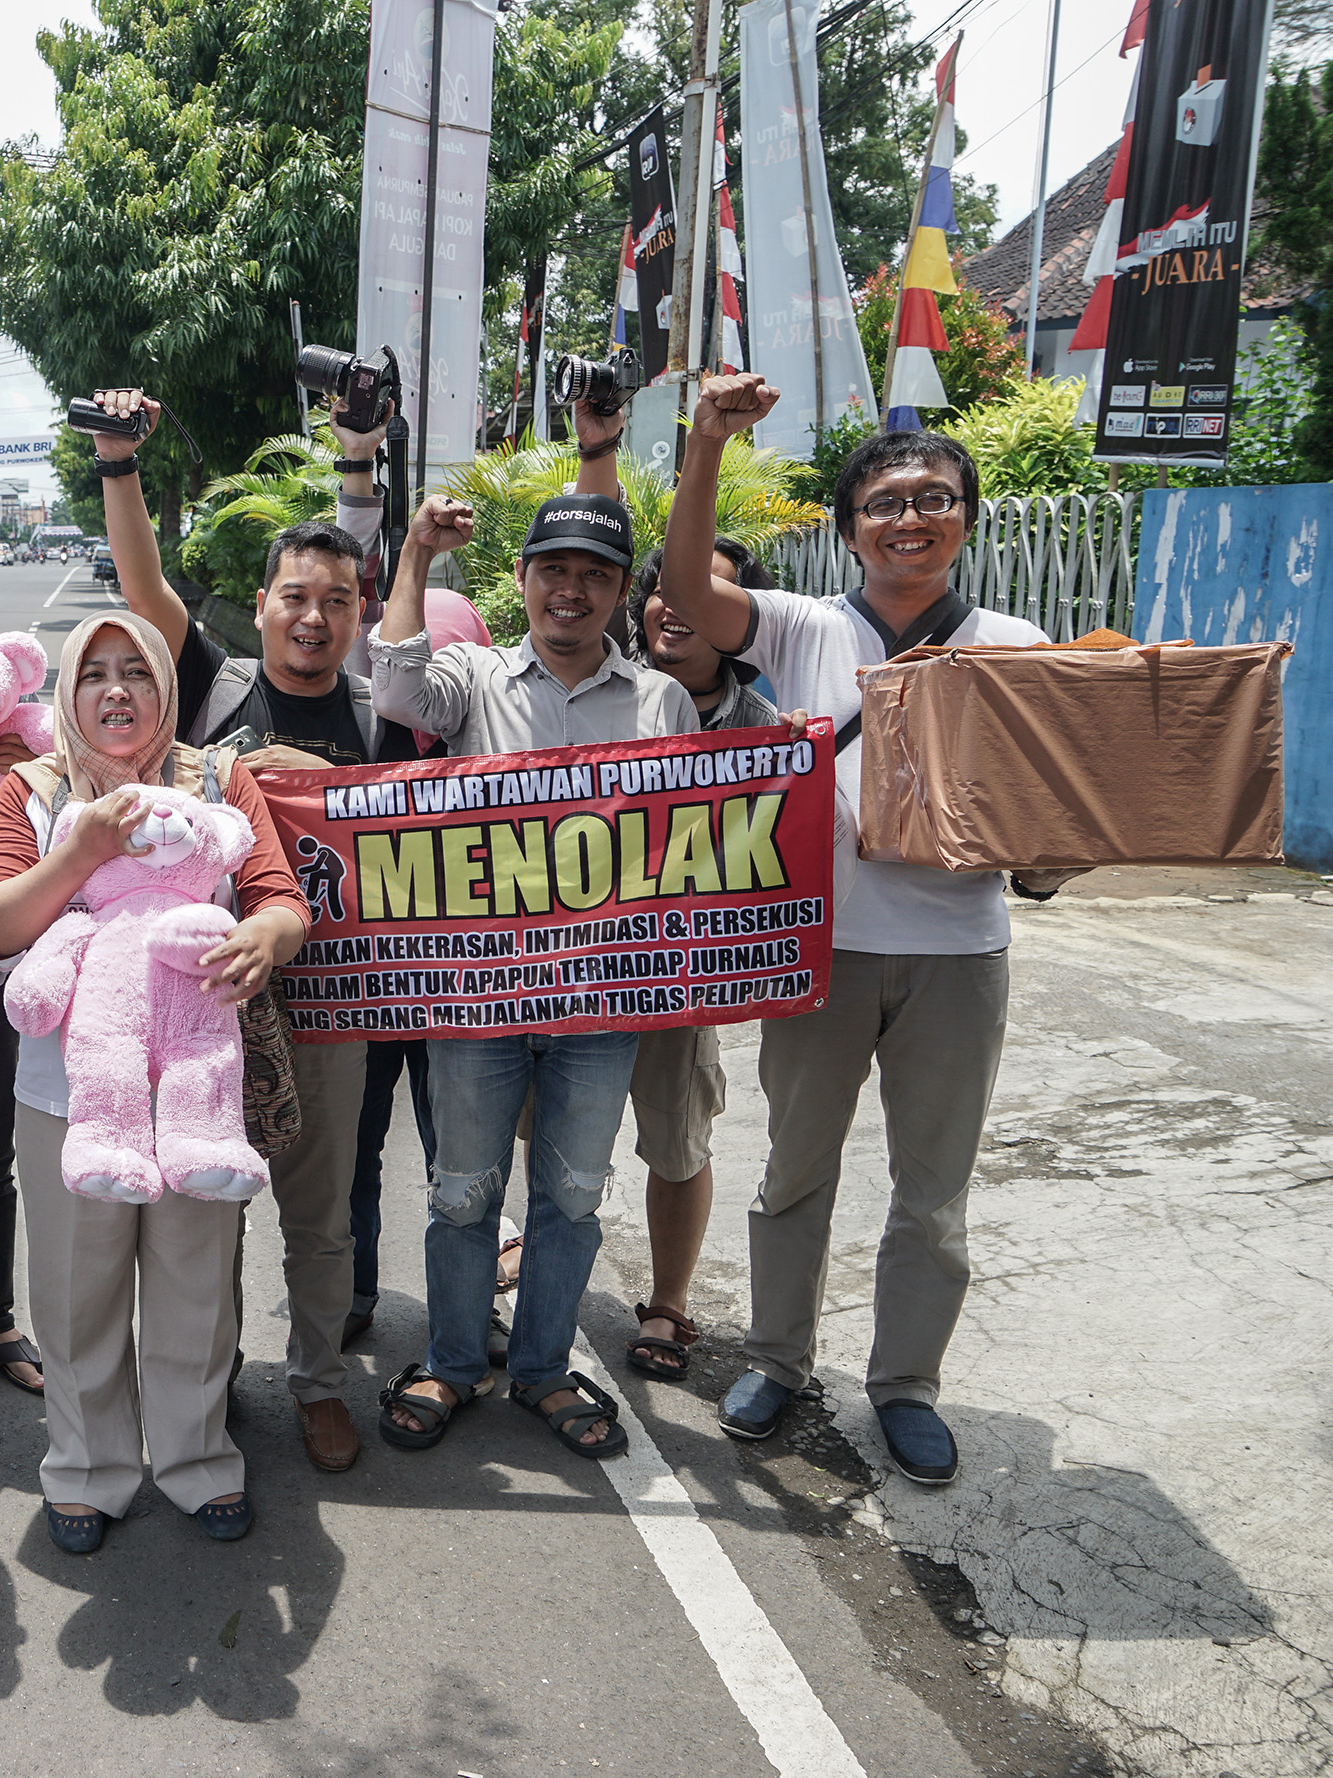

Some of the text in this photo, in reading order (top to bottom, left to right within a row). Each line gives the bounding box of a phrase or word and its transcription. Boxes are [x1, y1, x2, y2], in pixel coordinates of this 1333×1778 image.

[1209, 221, 1238, 245] ITU
[34, 442, 52, 452] BRI
[544, 509, 623, 533] #dorsajalah
[326, 740, 814, 820] KAMI WARTAWAN PURWOKERTO
[356, 791, 791, 923] MENOLAK
[524, 913, 657, 953] INTIMIDASI
[664, 912, 692, 942] &
[692, 898, 823, 939] PERSEKUSI
[283, 937, 799, 1001] DALAM BENTUK APAPUN TERHADAP JURNALIS
[290, 971, 812, 1030] ANG SEDANG MENJALANKAN TUGAS PELIPUTAN
